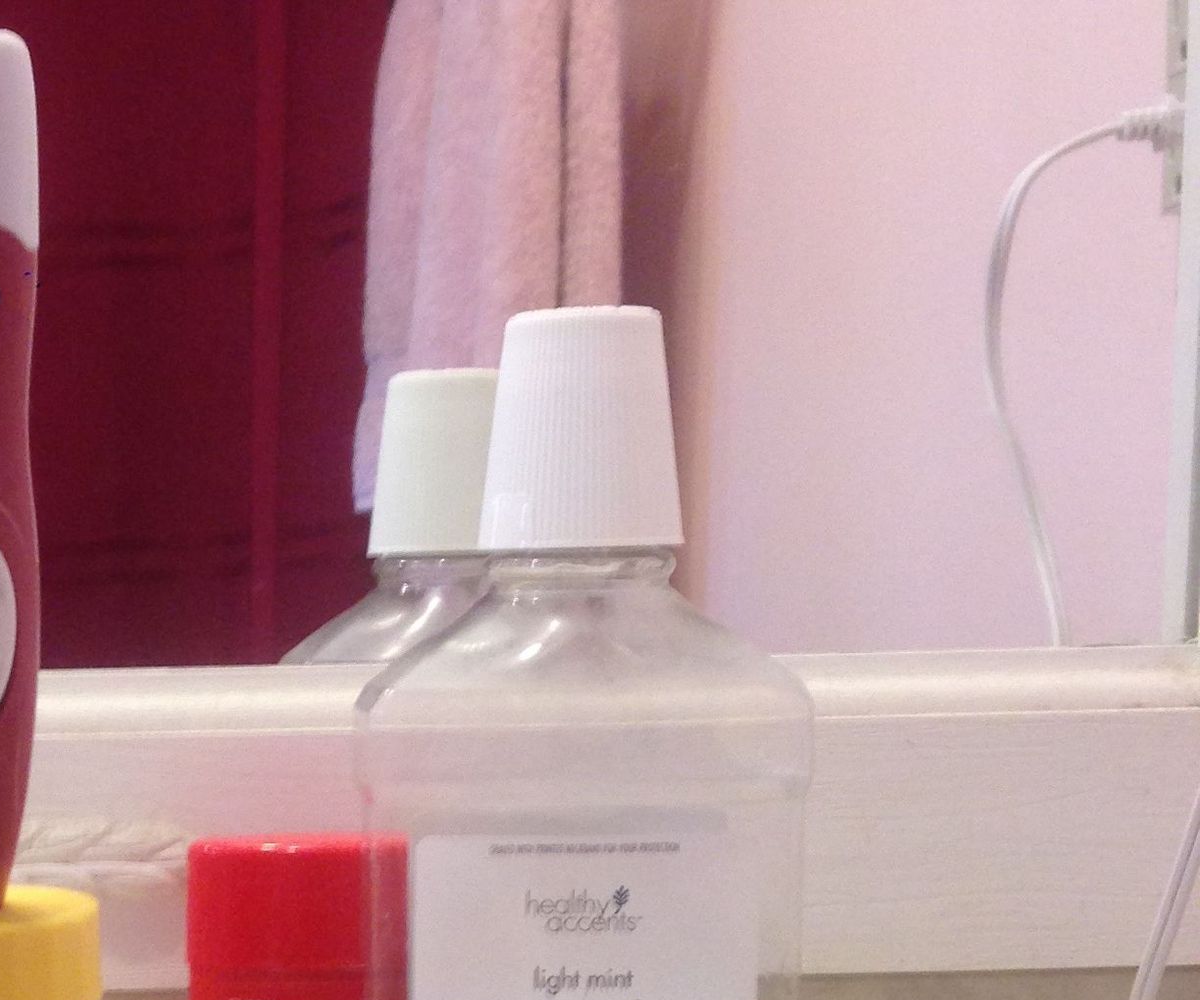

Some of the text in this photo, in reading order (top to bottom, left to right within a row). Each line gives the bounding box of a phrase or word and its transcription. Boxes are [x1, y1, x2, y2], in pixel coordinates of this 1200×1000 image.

[525, 888, 611, 917] healthy
[545, 912, 639, 933] accents
[533, 966, 634, 995] light mint
